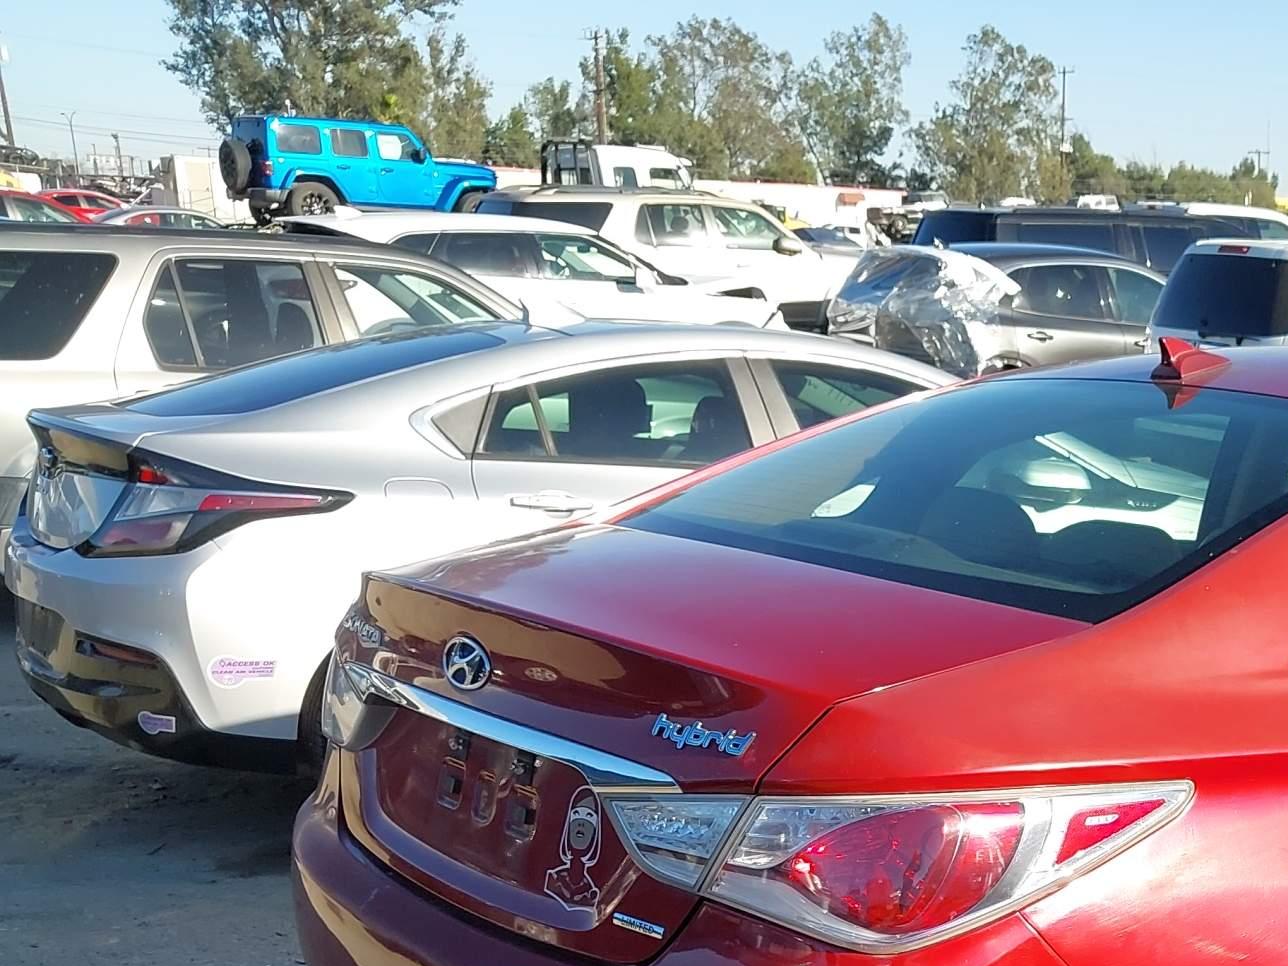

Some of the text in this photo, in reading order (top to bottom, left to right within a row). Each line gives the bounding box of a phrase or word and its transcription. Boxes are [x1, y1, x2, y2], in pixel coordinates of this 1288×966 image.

[342, 614, 380, 643] SONATA
[651, 712, 757, 756] hybrid
[621, 916, 656, 934] LIMITED
